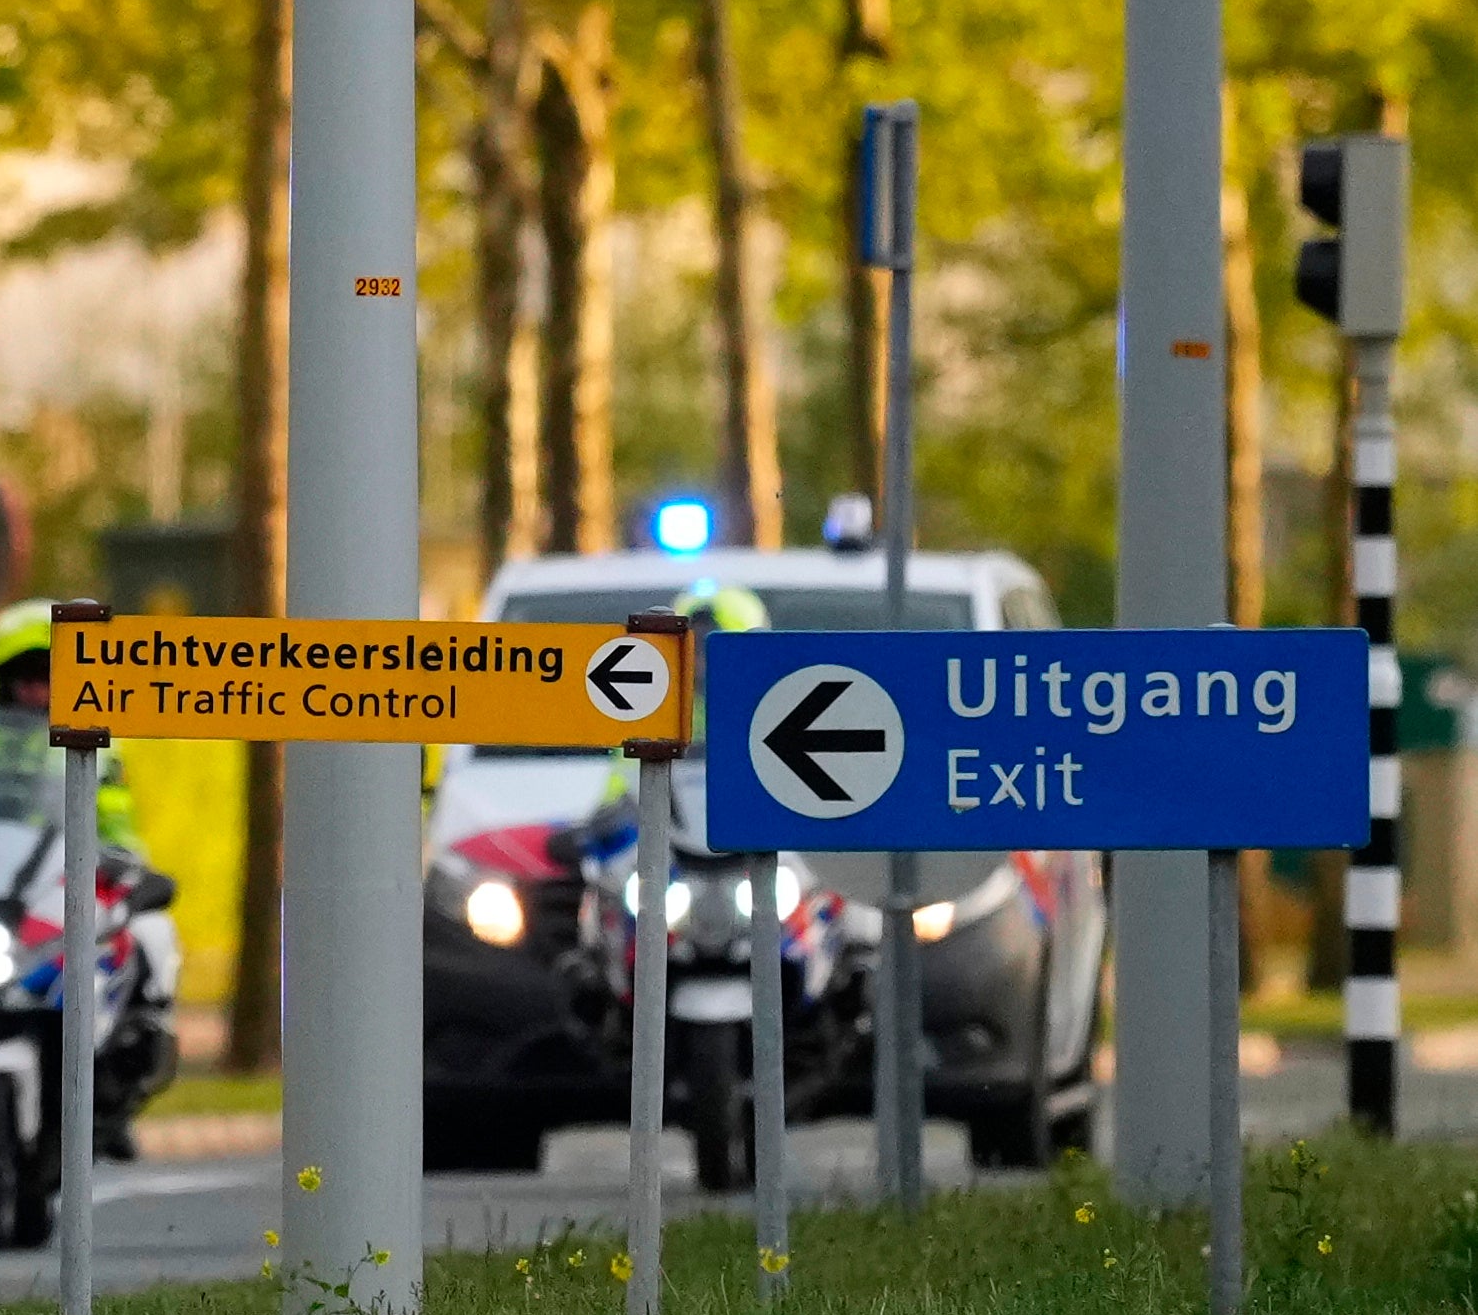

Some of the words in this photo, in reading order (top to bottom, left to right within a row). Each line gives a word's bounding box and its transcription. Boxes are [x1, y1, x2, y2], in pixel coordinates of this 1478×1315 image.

[356, 278, 400, 296] 2932
[75, 631, 563, 682] Luchtverkeersleiding
[73, 680, 134, 713] Air
[149, 680, 286, 715] Traffic
[302, 685, 457, 719] Control
[947, 655, 1296, 734] Uitgang
[948, 746, 1083, 811] Exit
